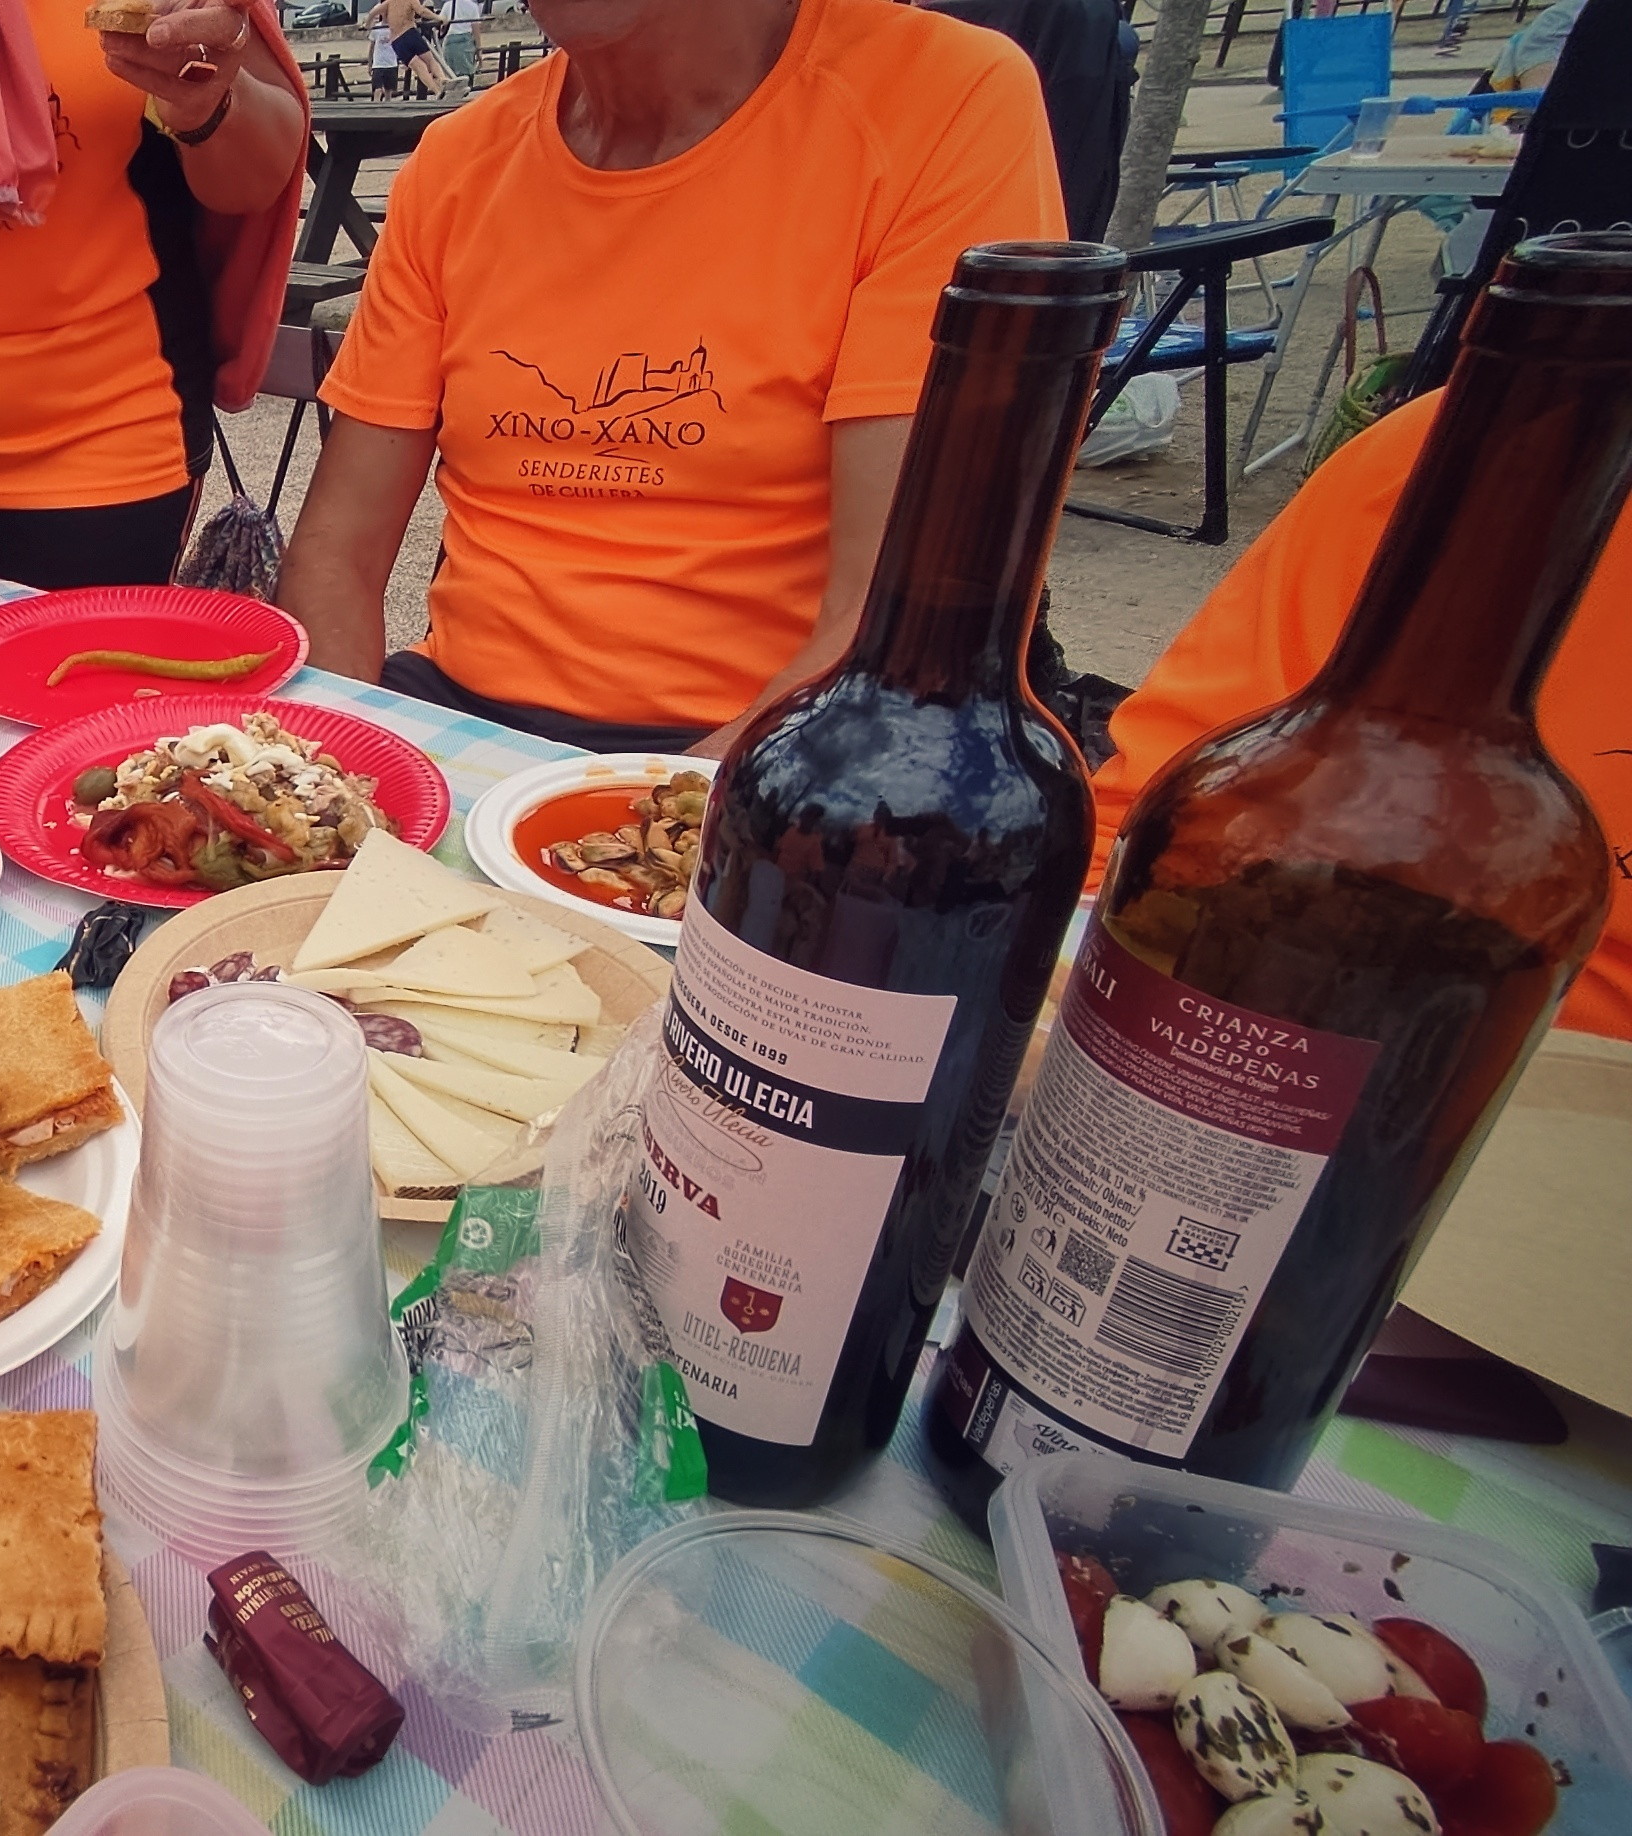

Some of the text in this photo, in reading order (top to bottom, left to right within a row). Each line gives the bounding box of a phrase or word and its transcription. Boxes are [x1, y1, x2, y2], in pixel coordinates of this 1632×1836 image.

[485, 411, 706, 449] XINO-XANO
[518, 459, 665, 486] SENDERISTES
[1081, 952, 1118, 1001] BALI
[703, 980, 759, 1022] PRODUCCIÓN
[761, 1017, 776, 1030] DE
[779, 1025, 808, 1043] UVAS
[811, 1037, 828, 1050] DE
[830, 1043, 865, 1059] GRAN
[712, 975, 763, 1013] ENCUENTRA
[767, 1009, 791, 1026] ESTA
[795, 1020, 841, 1041] REGIÓN
[846, 1034, 893, 1050] DONDE
[749, 987, 762, 999] DE
[765, 994, 800, 1015] MAYOR
[803, 1010, 871, 1035] TRADICIÓN.
[760, 980, 800, 1000] DECIDE
[801, 996, 809, 1006] A
[813, 1000, 864, 1020] APOSTAR
[710, 1013, 748, 1048] DESDE
[751, 1040, 789, 1066] 1899
[1178, 997, 1310, 1054] CRIANZA
[1201, 1025, 1270, 1057] 2020
[669, 1010, 723, 1085] RIVERO
[724, 1065, 814, 1129] ULECIA
[1150, 1017, 1321, 1089] VALDEPEÑAS
[1170, 1046, 1232, 1080] Denominación
[1233, 1072, 1246, 1084] de
[638, 1158, 667, 1215] 2019
[1063, 1179, 1102, 1215] Contenuto
[1114, 1175, 1124, 1189] 13
[735, 1239, 793, 1268] FAMILIA
[1106, 1225, 1129, 1248] Neto
[717, 1255, 803, 1294] CENTENARIA
[723, 1246, 802, 1283] BODEGUERA
[1222, 1296, 1247, 1338] 000215
[683, 1310, 802, 1377] UTIEL-REQUENA
[671, 1350, 739, 1400] TENARIA
